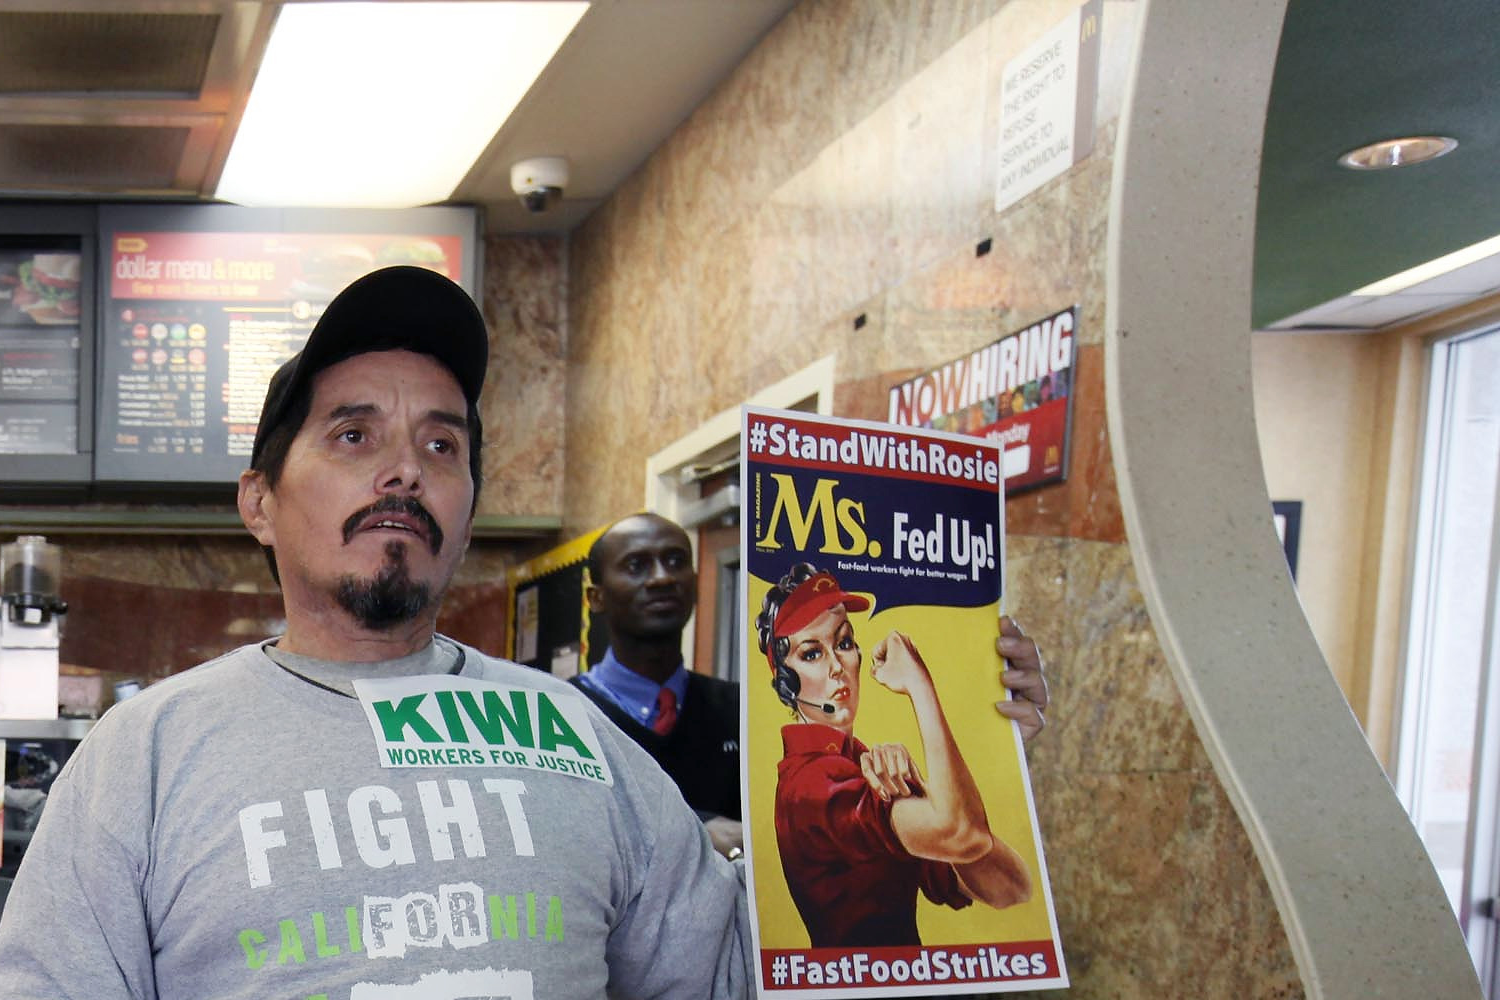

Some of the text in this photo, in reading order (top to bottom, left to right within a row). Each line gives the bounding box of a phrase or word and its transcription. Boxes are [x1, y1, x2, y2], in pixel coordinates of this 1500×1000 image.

[116, 256, 161, 279] dollar
[166, 261, 212, 279] menu
[889, 312, 1073, 427] NOW HIRING
[750, 421, 998, 484] #StandWithRosie
[756, 473, 882, 558] Ms.
[893, 511, 995, 581] Fed Up!
[838, 561, 967, 581] Fast-food workers fight for better wages
[372, 690, 596, 760] KIWA
[386, 748, 606, 781] WORKERS FOR JUSTICE
[238, 778, 536, 889] FIGHT
[772, 948, 1047, 986] #FastFoodStrikes
